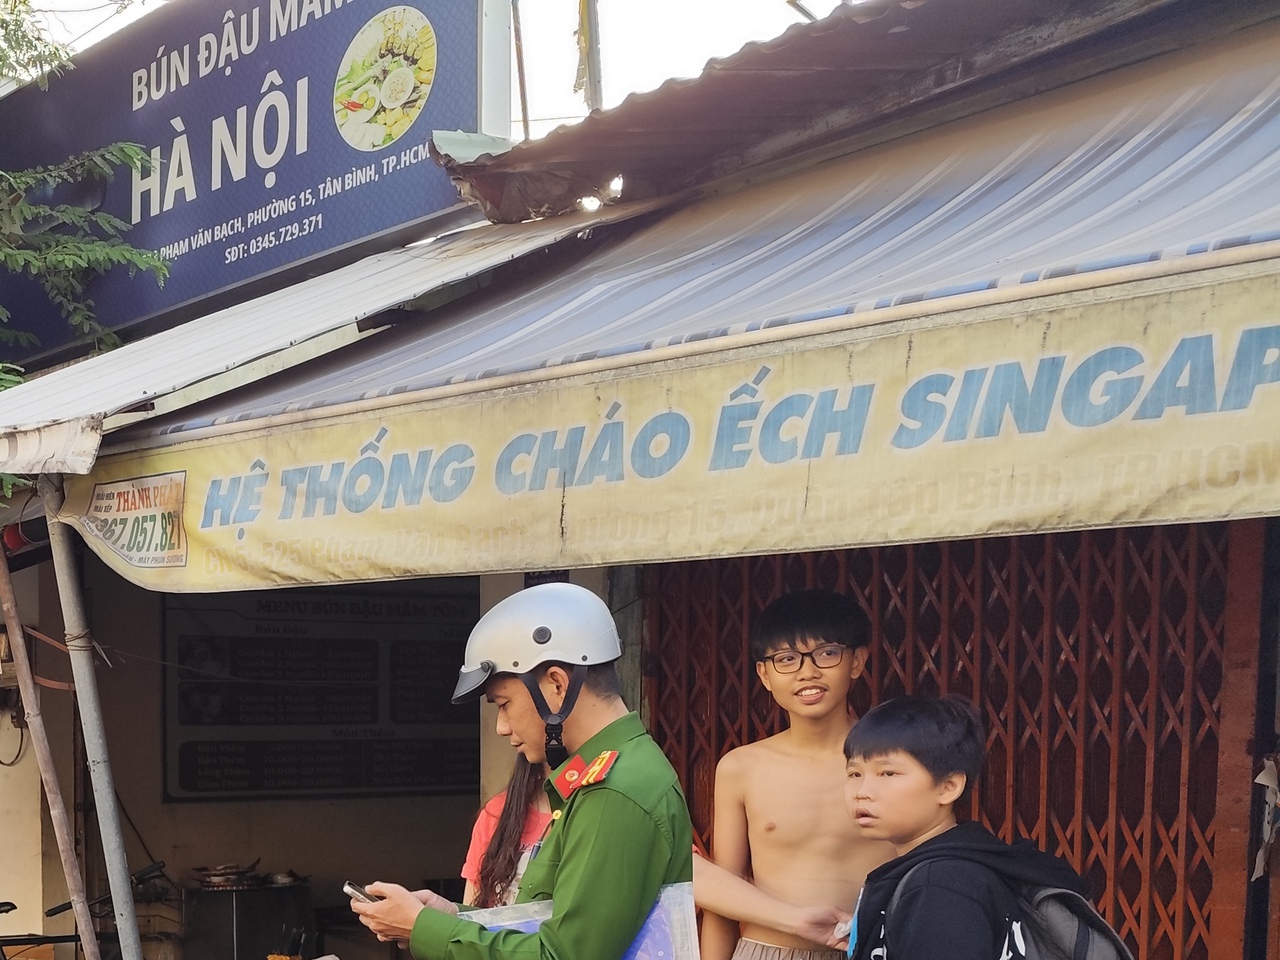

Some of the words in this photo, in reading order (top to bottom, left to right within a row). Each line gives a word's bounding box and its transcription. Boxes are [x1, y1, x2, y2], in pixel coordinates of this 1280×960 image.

[132, 44, 190, 112] BÚN
[197, 6, 260, 76] ĐẬU
[130, 116, 197, 225] HÀ
[211, 70, 309, 191] NỘI
[160, 239, 189, 261] PHẠM
[191, 227, 212, 250] VĂN
[214, 219, 245, 242] BẠCH,
[247, 197, 296, 229] PHƯỜNG
[299, 189, 316, 208] 15,
[318, 177, 342, 200] TÂN
[345, 166, 379, 190] BÌNH,
[381, 142, 431, 176] TP.HCM
[225, 245, 248, 264] SĐT:
[249, 213, 324, 256] 0345.729.371
[115, 483, 153, 513] THÀNH
[201, 458, 270, 541] HỆ
[278, 426, 475, 521] THỐNG
[496, 401, 691, 496] CHÁO
[708, 365, 875, 472] ẾCH
[260, 538, 303, 569] 525
